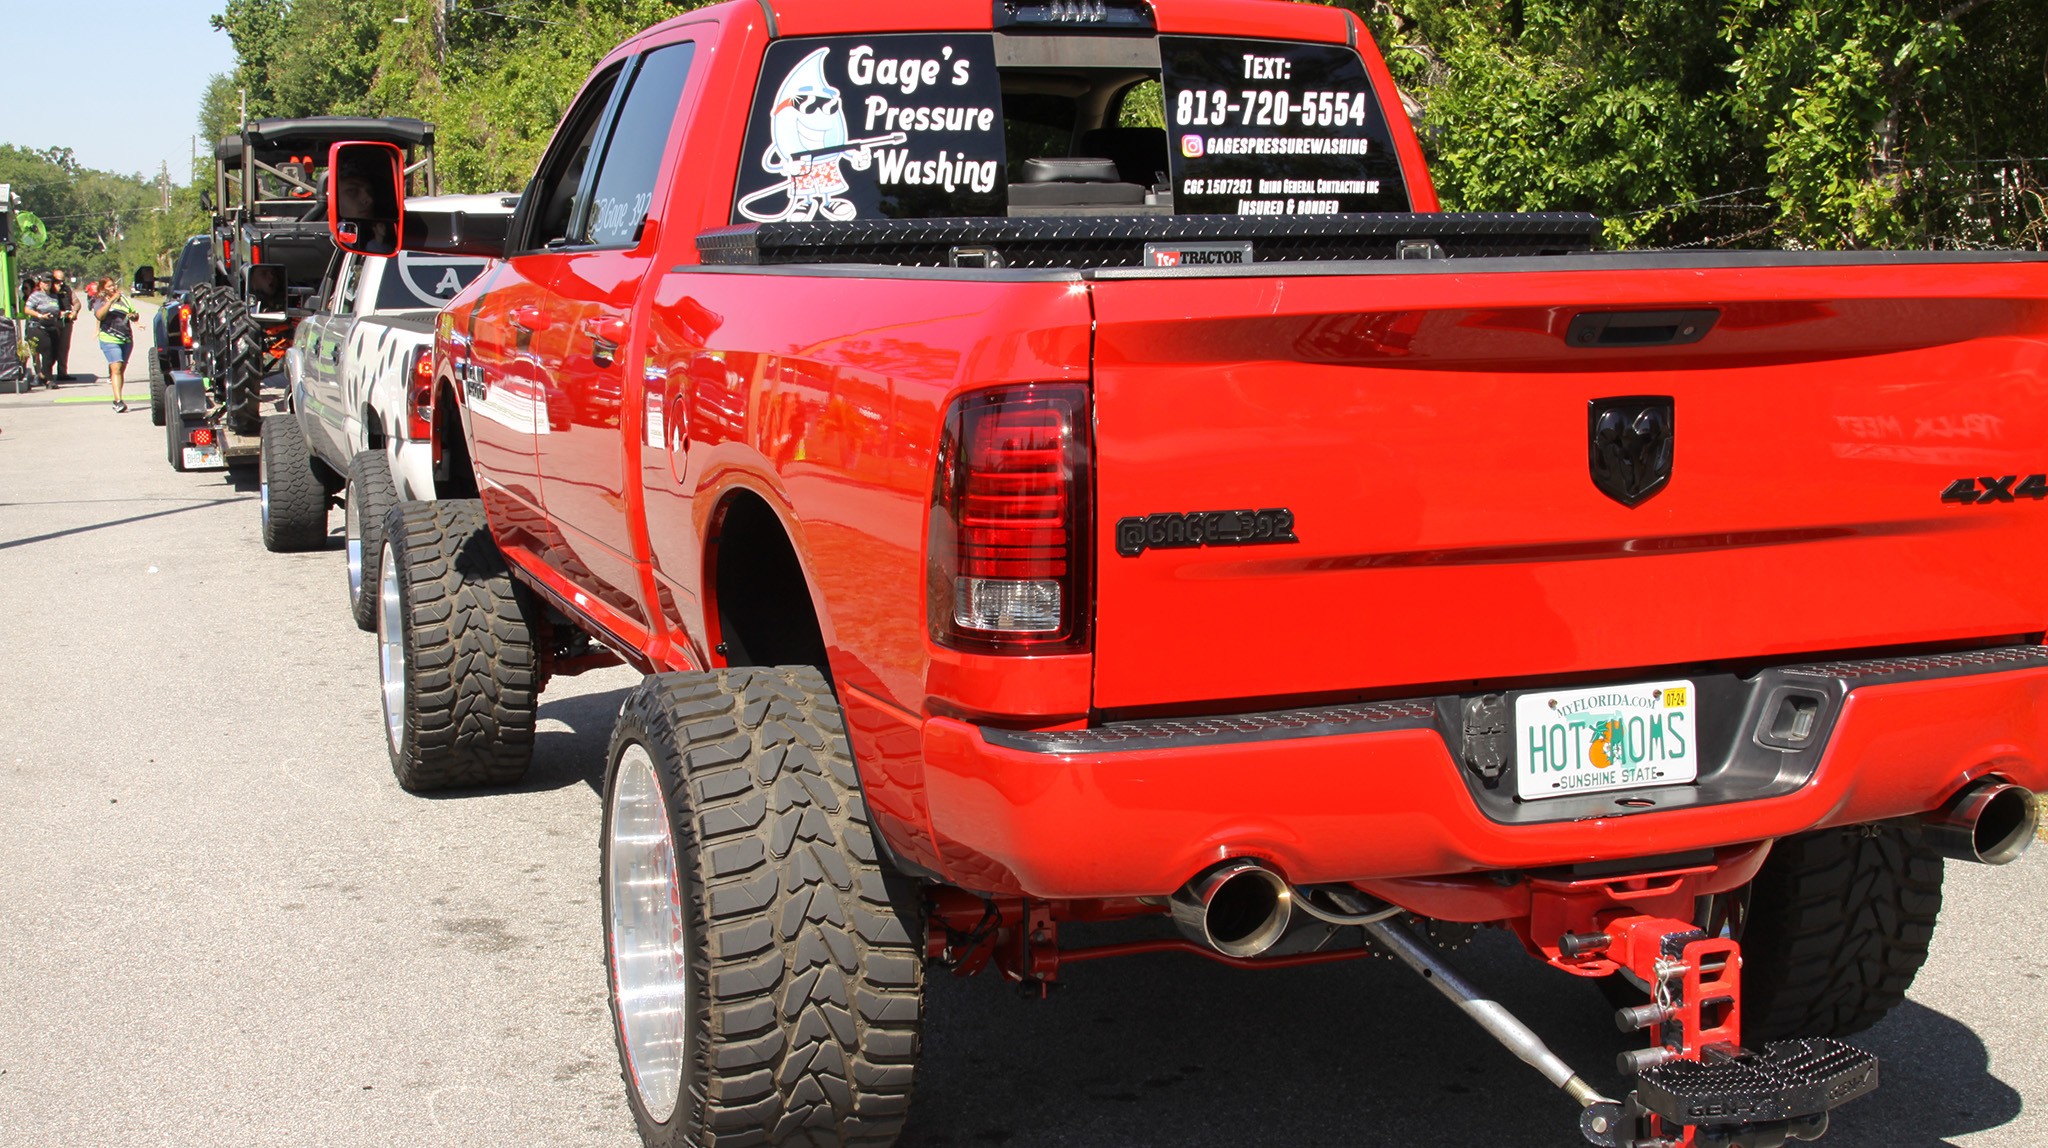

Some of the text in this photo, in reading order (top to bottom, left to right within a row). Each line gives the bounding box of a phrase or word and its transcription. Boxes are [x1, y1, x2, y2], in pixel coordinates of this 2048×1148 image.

[848, 46, 969, 94] Gage's
[1243, 55, 1290, 79] TEXT:
[864, 95, 995, 131] Pressure
[1177, 90, 1365, 126] 813-720-5554
[1207, 138, 1367, 154] GAGESPRESSUREWASHING
[873, 149, 998, 194] Washing
[1206, 179, 1252, 194] 1507291
[1283, 179, 1315, 193] GENERAL
[1317, 179, 1365, 193] CONTRACTING
[1238, 199, 1338, 215] INSURED & BONDED
[1181, 250, 1243, 264] TRACTOR
[1940, 473, 2048, 505] 4X4
[1557, 693, 1656, 718] MYFLORIDA.COM
[1529, 711, 1686, 773] HOT MOMS
[1560, 766, 1658, 789] SUNSHINE STATE
